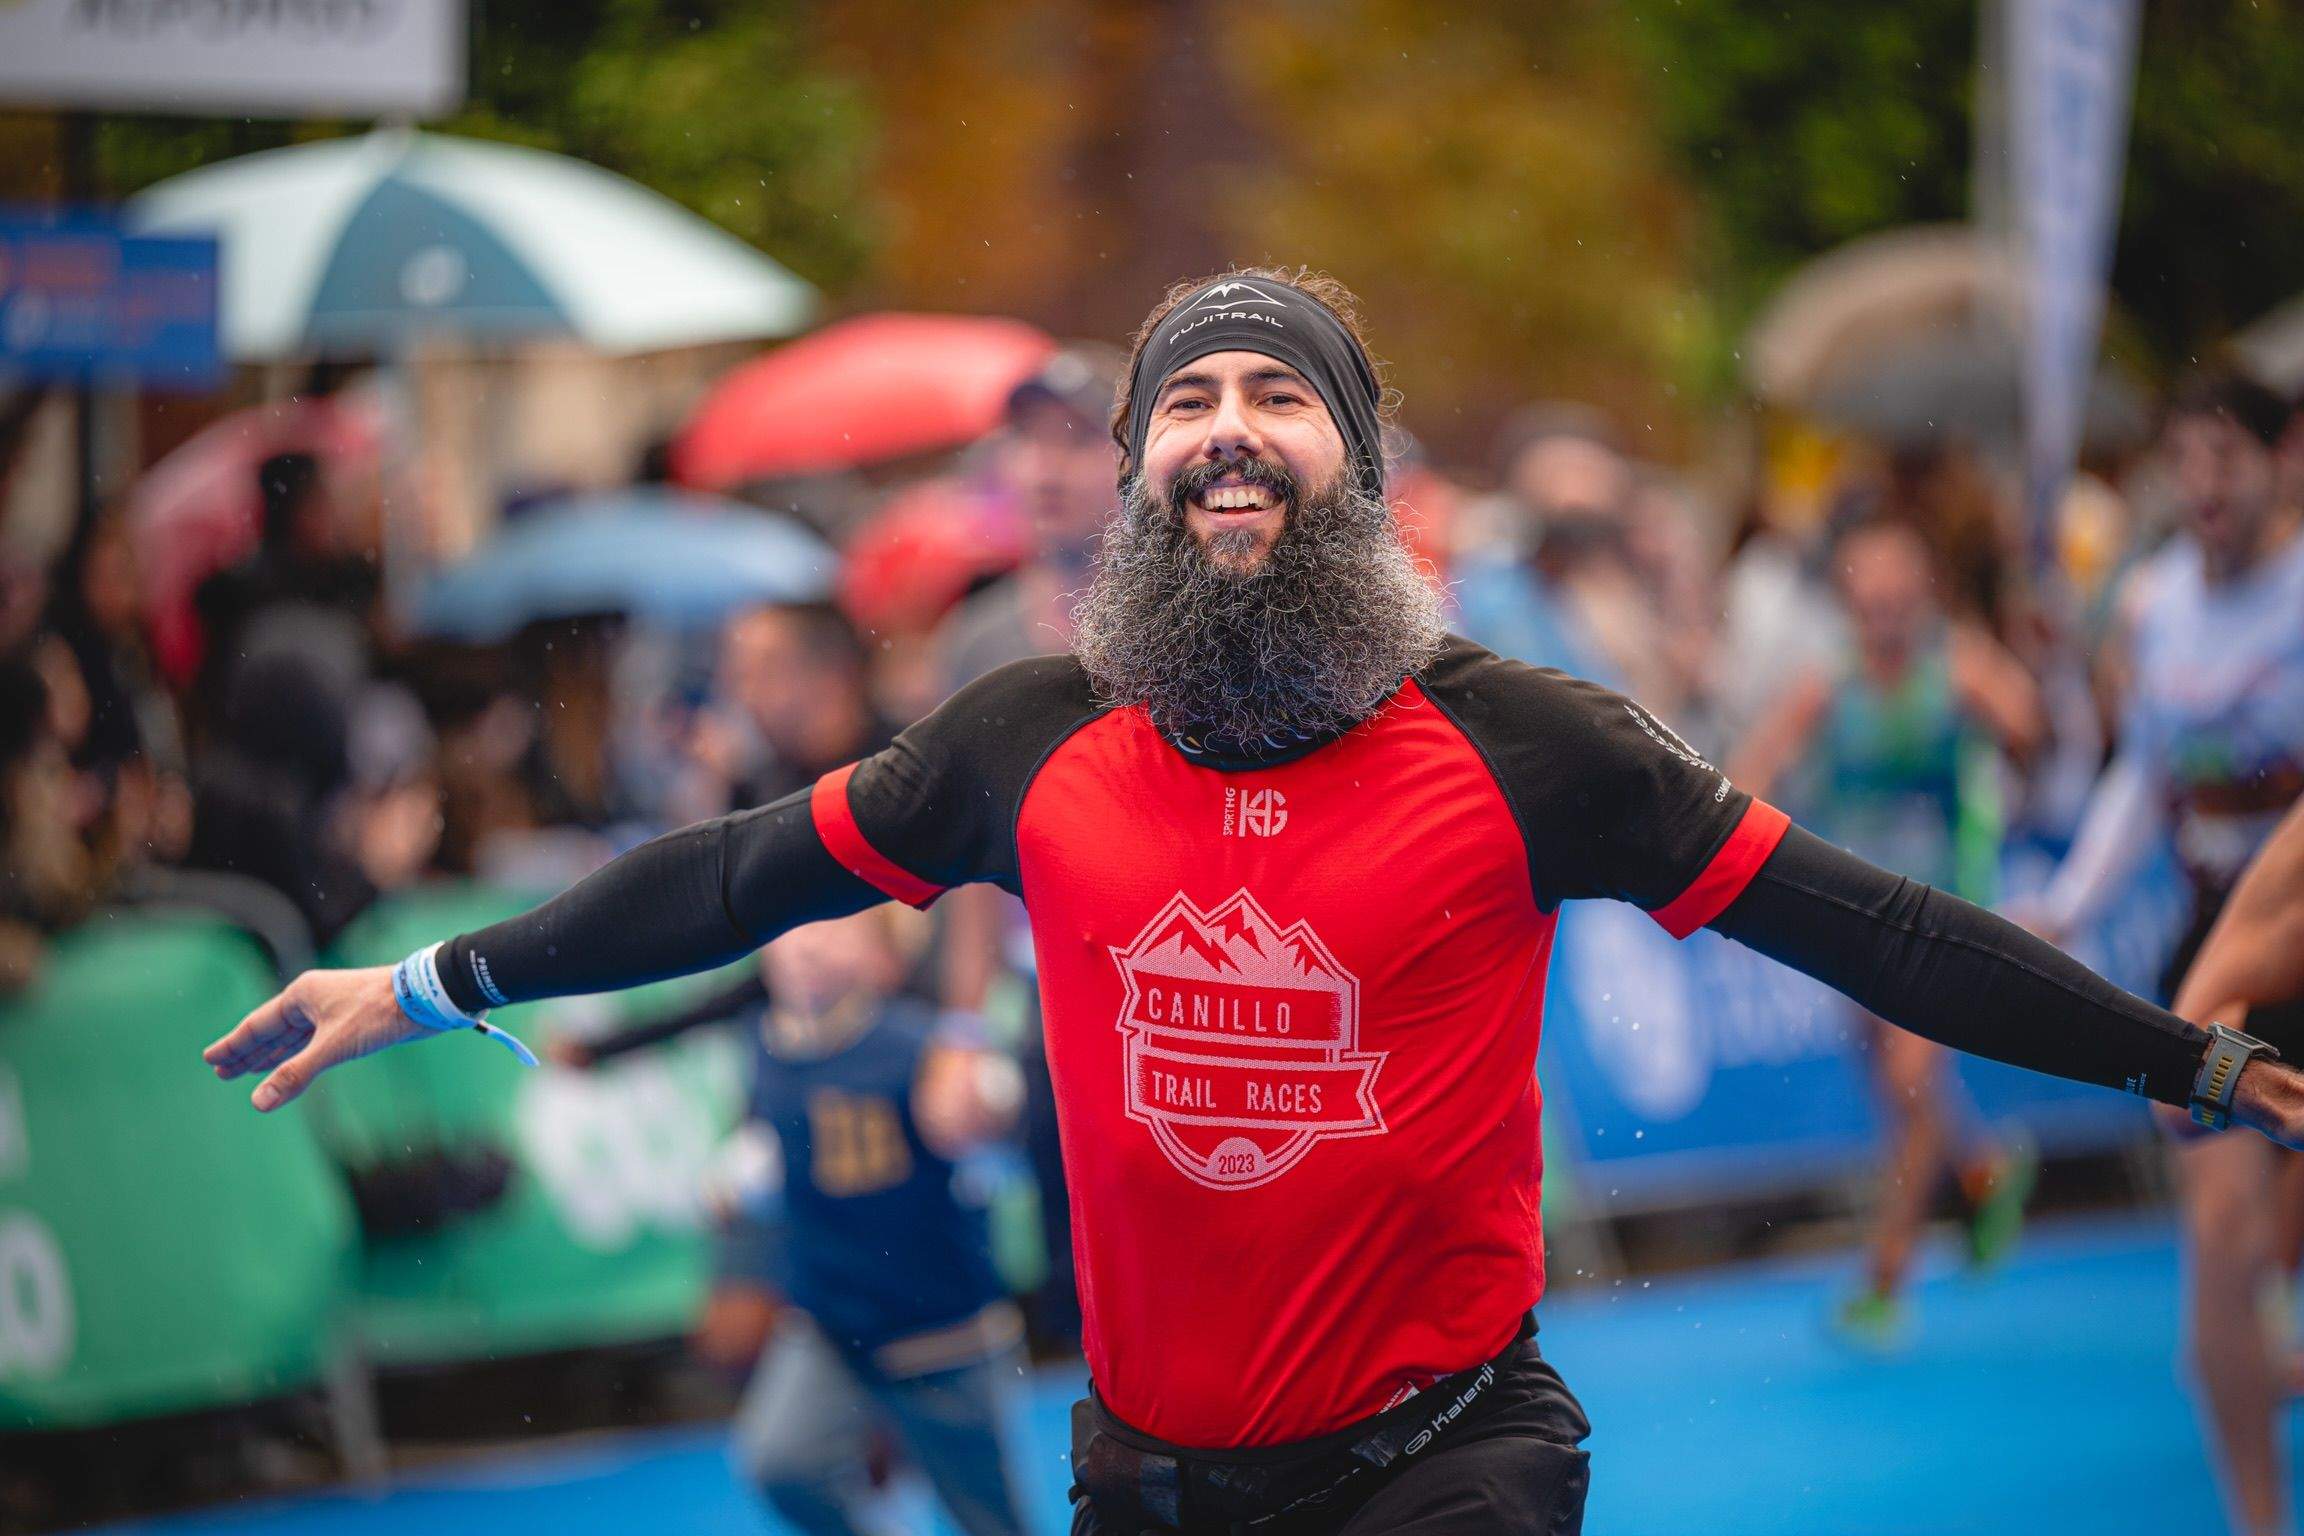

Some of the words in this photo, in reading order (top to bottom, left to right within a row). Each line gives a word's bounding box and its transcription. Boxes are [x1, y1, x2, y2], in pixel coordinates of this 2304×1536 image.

[1169, 312, 1284, 344] FUJITRAIL
[1148, 988, 1291, 1034] CANILLO
[1153, 1071, 1217, 1109] TRAIL
[1246, 1081, 1322, 1114] RACES
[1218, 1153, 1255, 1175] 2023
